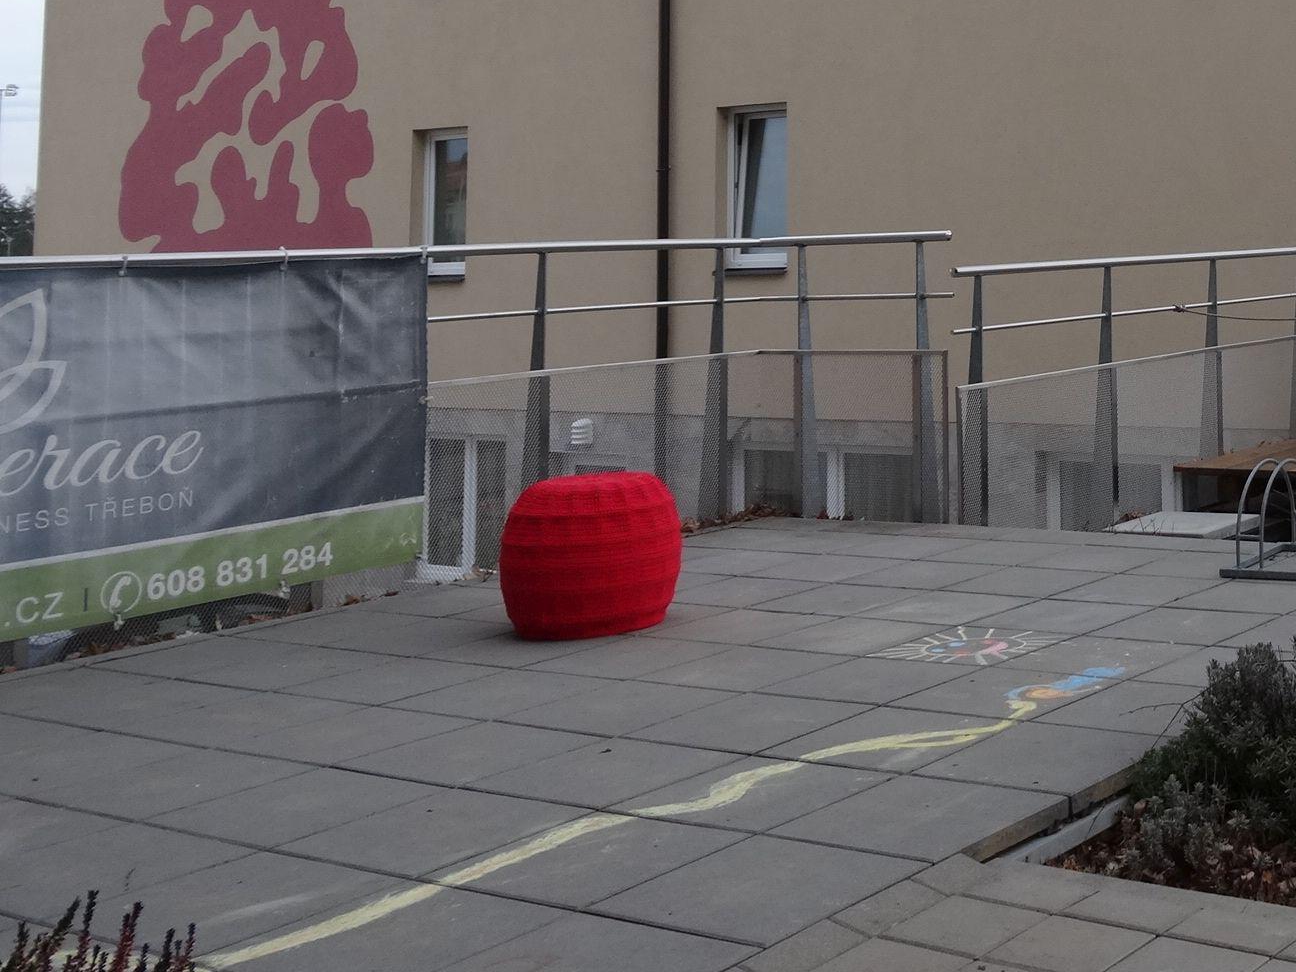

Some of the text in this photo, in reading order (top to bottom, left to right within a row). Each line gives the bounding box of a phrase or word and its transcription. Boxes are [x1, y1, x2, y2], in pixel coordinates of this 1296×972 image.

[85, 486, 194, 522] TŘEBOŇ
[147, 566, 206, 600] 608
[216, 554, 268, 587] 831
[281, 541, 334, 575] 284
